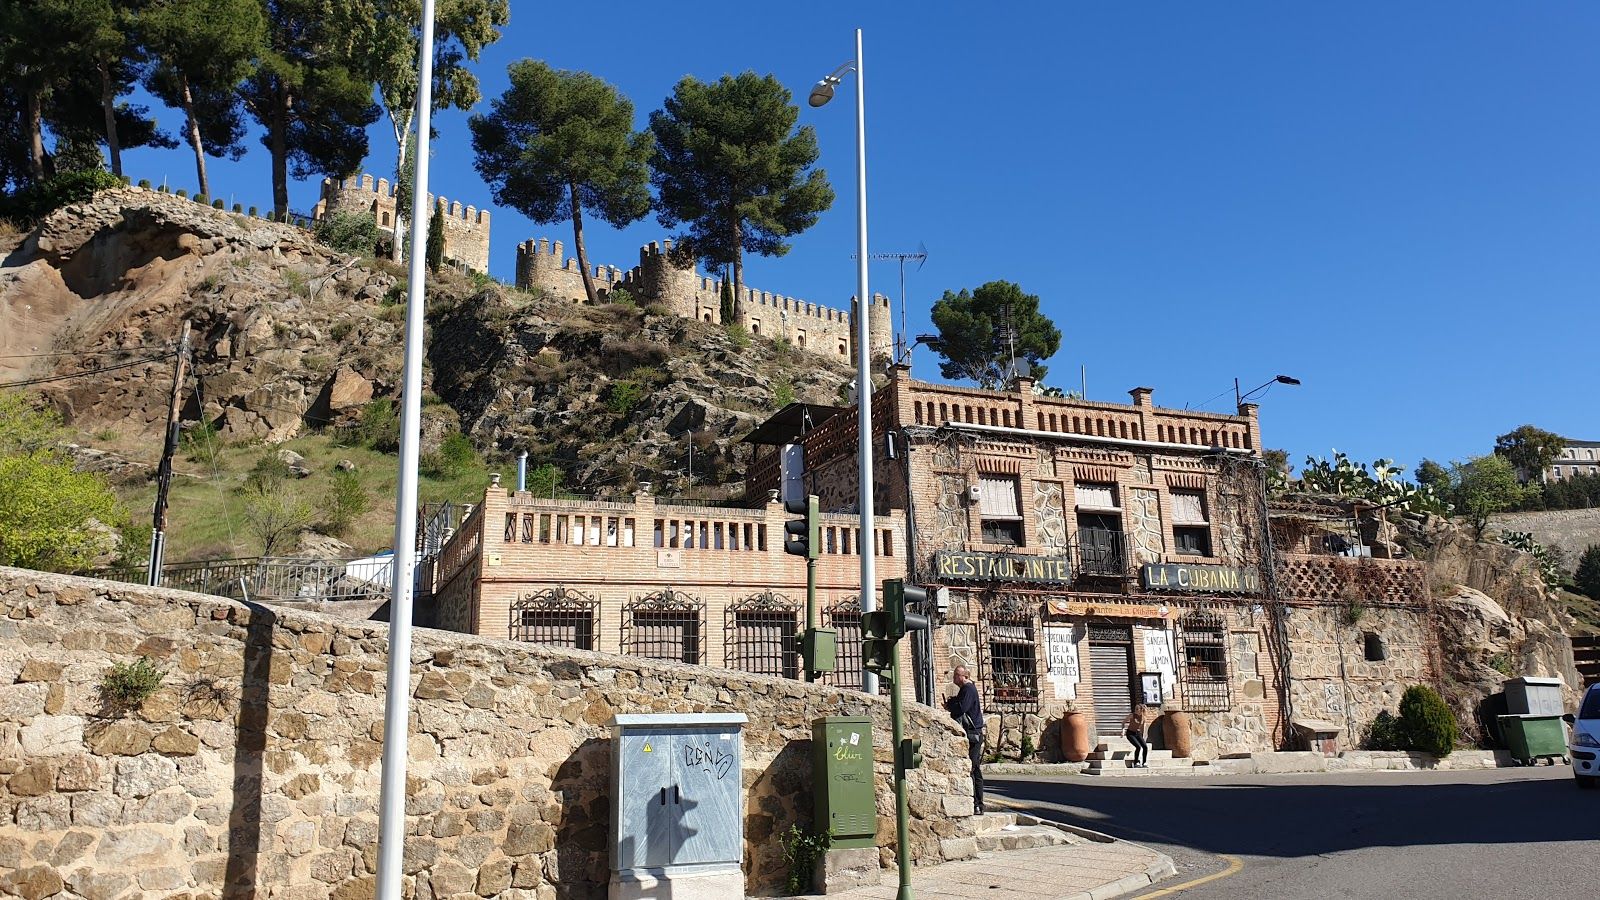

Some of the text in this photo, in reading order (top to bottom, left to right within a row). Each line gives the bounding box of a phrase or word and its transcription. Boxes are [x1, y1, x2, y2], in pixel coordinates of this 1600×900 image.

[940, 554, 1068, 580] RESTAURANTE
[1148, 566, 1169, 586] LA
[1177, 568, 1239, 589] CUBANA
[1069, 604, 1113, 614] Restante
[1052, 645, 1070, 653] DE LA
[1066, 655, 1075, 664] EN
